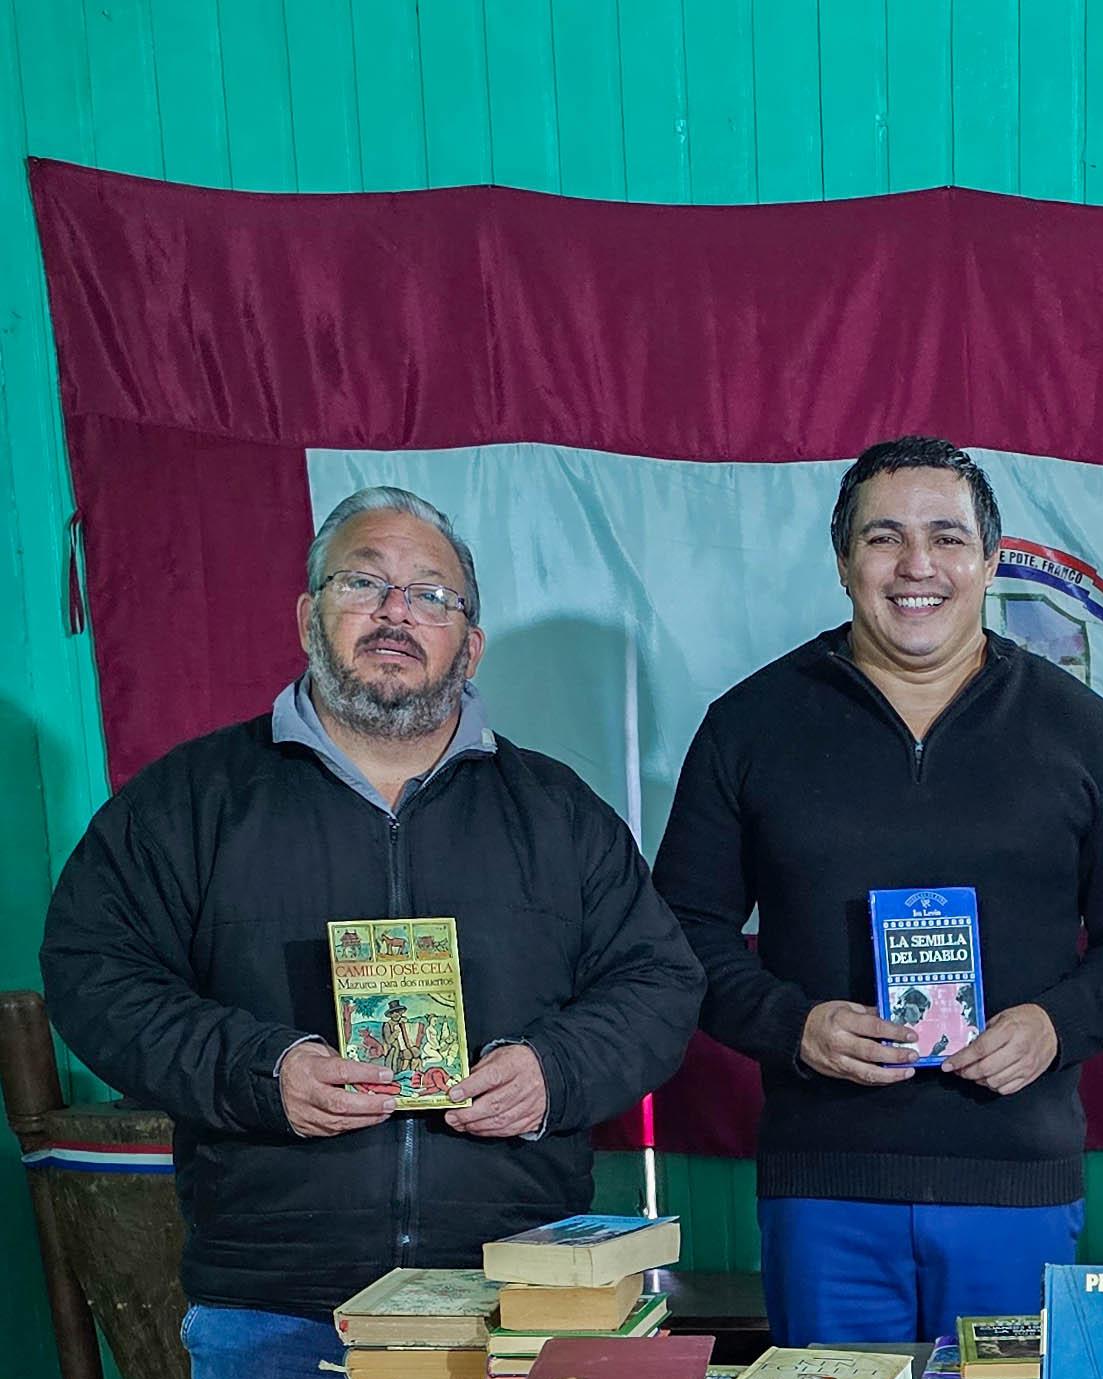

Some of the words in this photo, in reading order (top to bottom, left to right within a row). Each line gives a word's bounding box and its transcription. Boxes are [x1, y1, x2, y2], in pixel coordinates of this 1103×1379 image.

[1042, 560, 1083, 584] FRANCO
[889, 935, 909, 949] LA
[911, 933, 967, 948] SEMILLA
[891, 951, 917, 965] DEL
[919, 949, 968, 963] DIABLO
[335, 964, 387, 978] CAMILO
[390, 962, 420, 979] JOSÉ
[420, 962, 453, 975] CELA
[338, 978, 377, 990] Mazurca
[380, 980, 398, 993] para
[400, 977, 417, 987] dos
[418, 977, 454, 987] muertos
